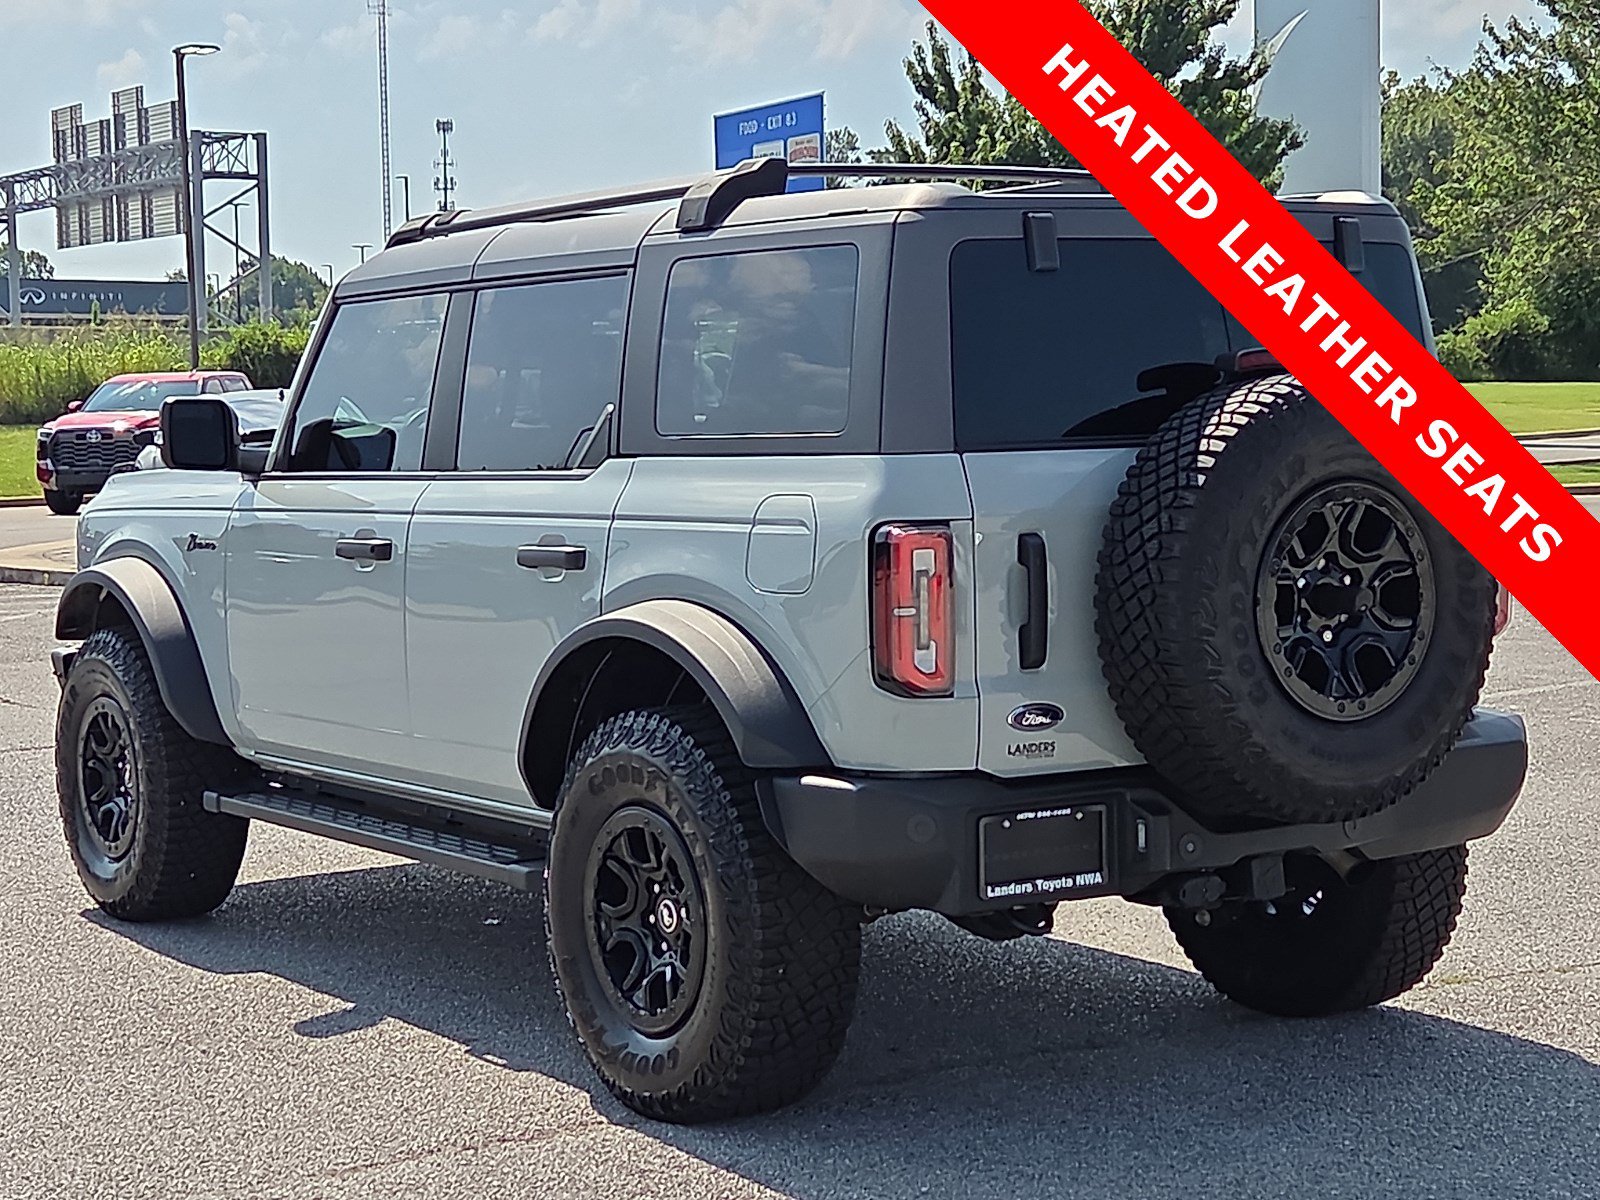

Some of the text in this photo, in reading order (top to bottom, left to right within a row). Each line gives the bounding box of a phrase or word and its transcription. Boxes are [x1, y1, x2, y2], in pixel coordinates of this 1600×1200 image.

[739, 119, 758, 135] FOOD
[767, 114, 782, 130] EXIT
[51, 292, 123, 301] INFINITI
[1021, 710, 1052, 726] Ford
[1007, 741, 1056, 757] LANDERS
[987, 871, 1103, 898] Landers Toyota NWA
